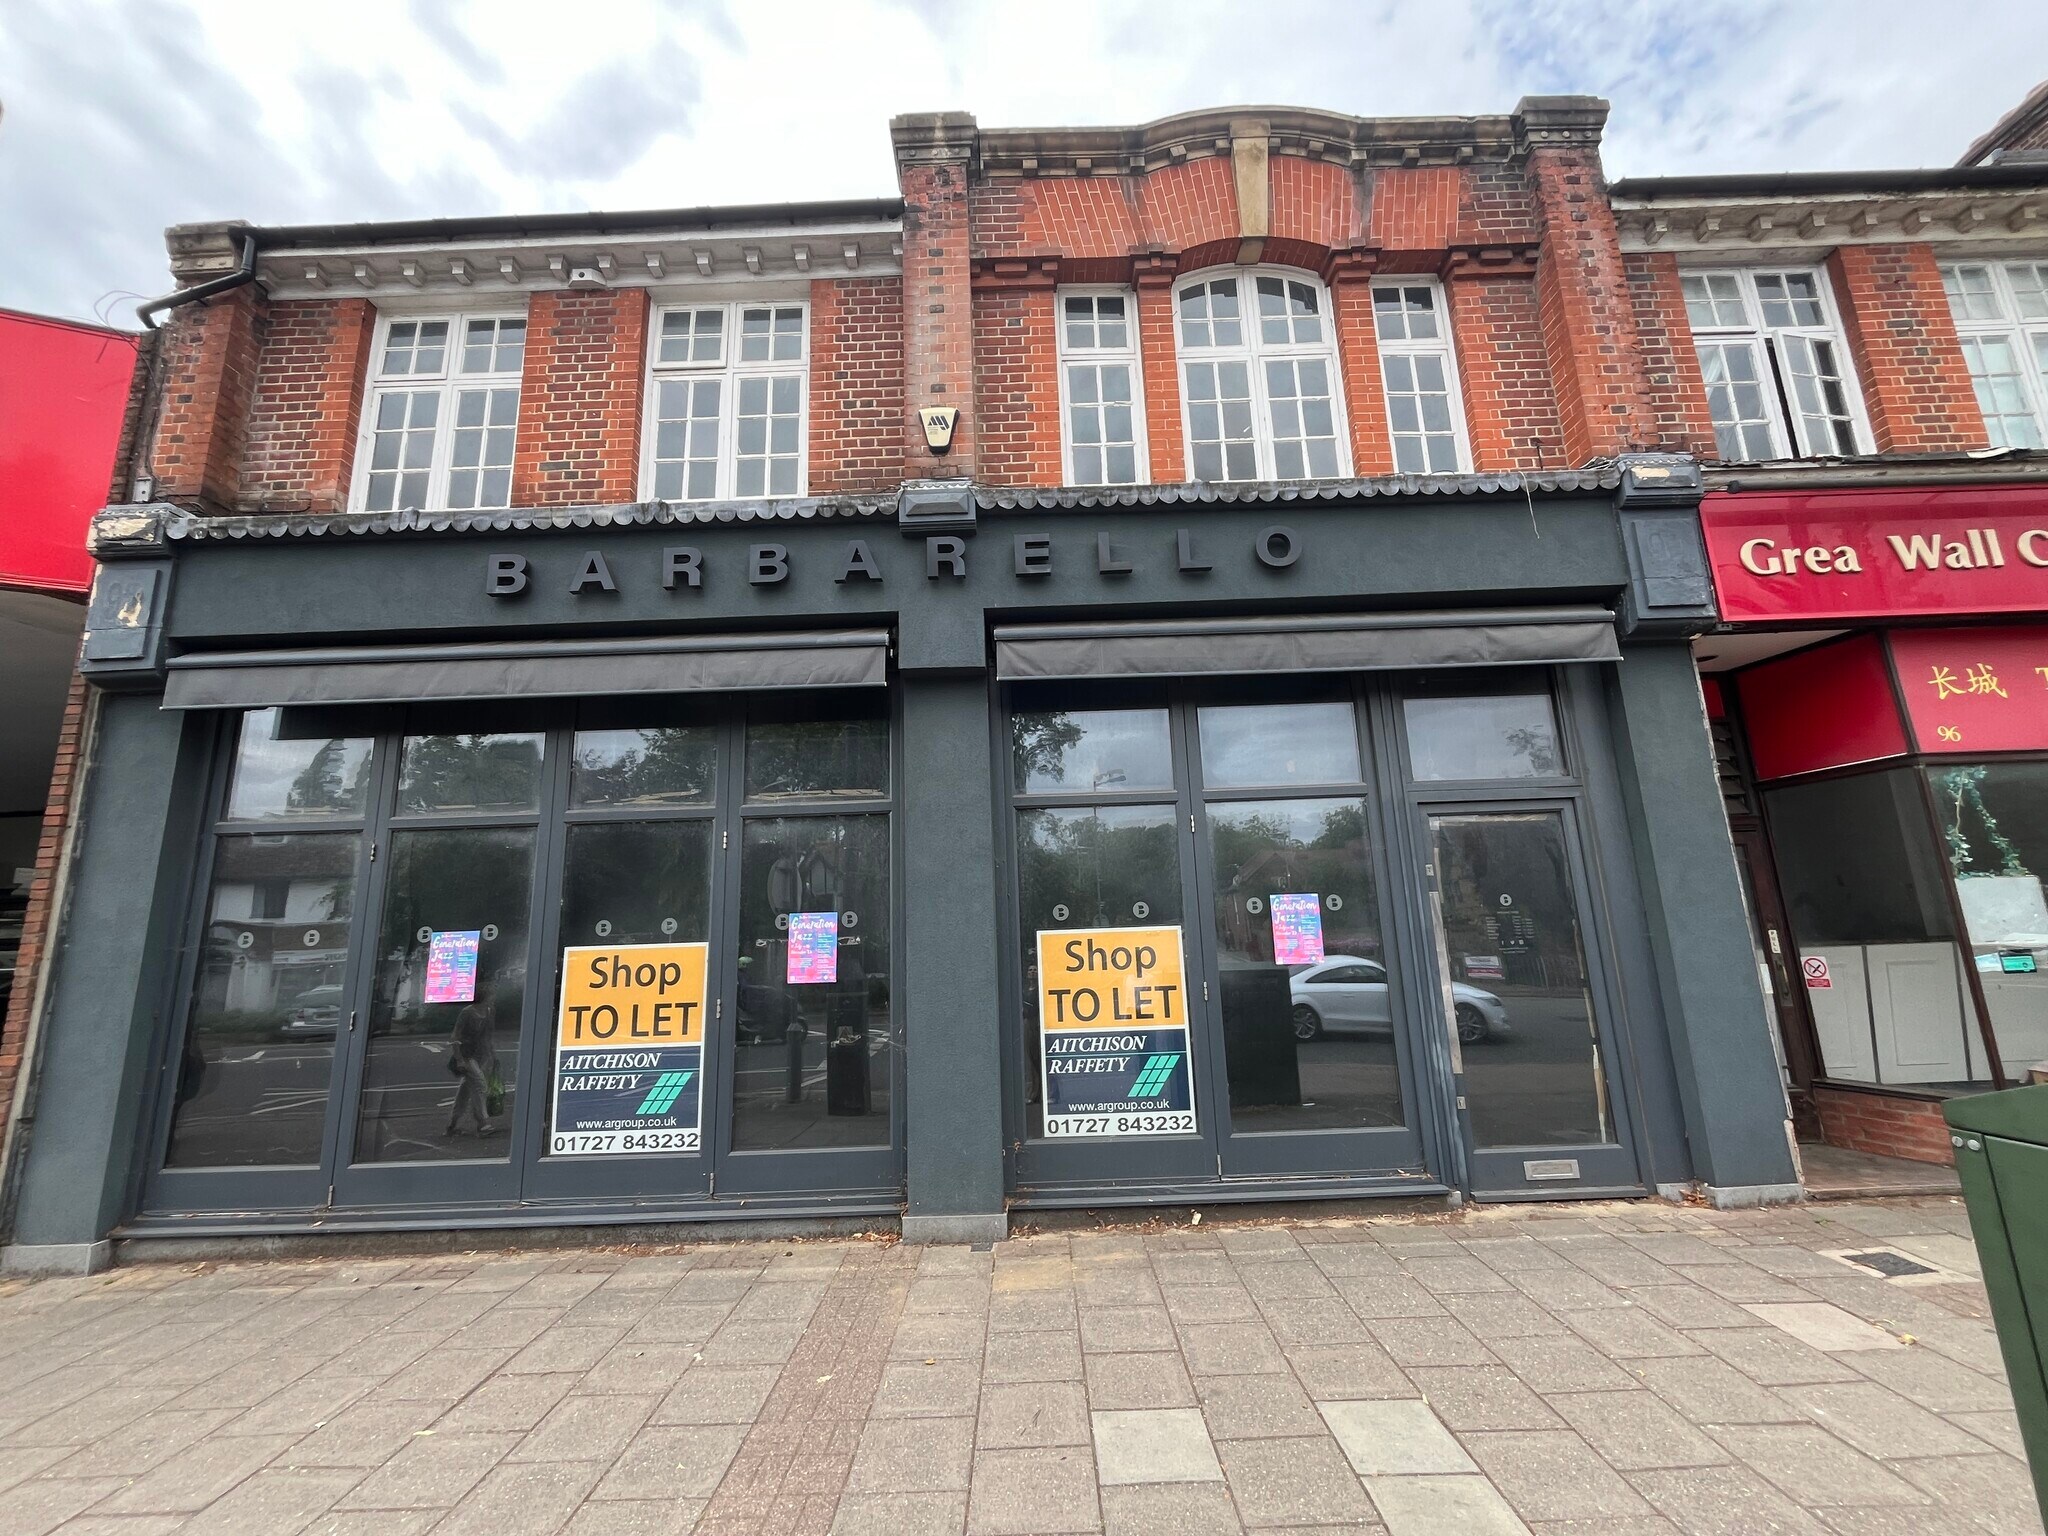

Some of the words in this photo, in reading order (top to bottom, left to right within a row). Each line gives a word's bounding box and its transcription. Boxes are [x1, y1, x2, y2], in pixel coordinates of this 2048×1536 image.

[1739, 538, 1862, 575] Grea
[1887, 528, 2005, 571] Wall
[485, 525, 1302, 597] BARBARELLO
[1928, 663, 2009, 700] 长城
[1937, 725, 1962, 743] 96
[1273, 898, 1317, 911] Generation
[792, 917, 835, 931] Generation
[1275, 911, 1296, 924] Jazz
[432, 935, 477, 949] Generation
[791, 930, 813, 943] Jazz
[431, 950, 454, 962] Jazz
[1065, 938, 1157, 979] Shop
[589, 955, 681, 995] Shop
[1048, 987, 1101, 1023] TO
[1112, 985, 1177, 1020] LET
[568, 1004, 619, 1040] TO
[631, 1002, 698, 1037] LET
[1047, 1035, 1147, 1054] AITCHISON
[561, 1052, 662, 1070] AITCHISON
[1048, 1057, 1131, 1074] RAFFETY
[560, 1074, 643, 1091] RAFFETY
[1068, 1099, 1170, 1113] www.argroup.co.uk
[576, 1116, 677, 1130] www.argroup.co.uk
[1047, 1118, 1110, 1134] 01727
[1117, 1115, 1194, 1132] 843232
[554, 1135, 616, 1152] 01727
[622, 1132, 699, 1150] 843232
